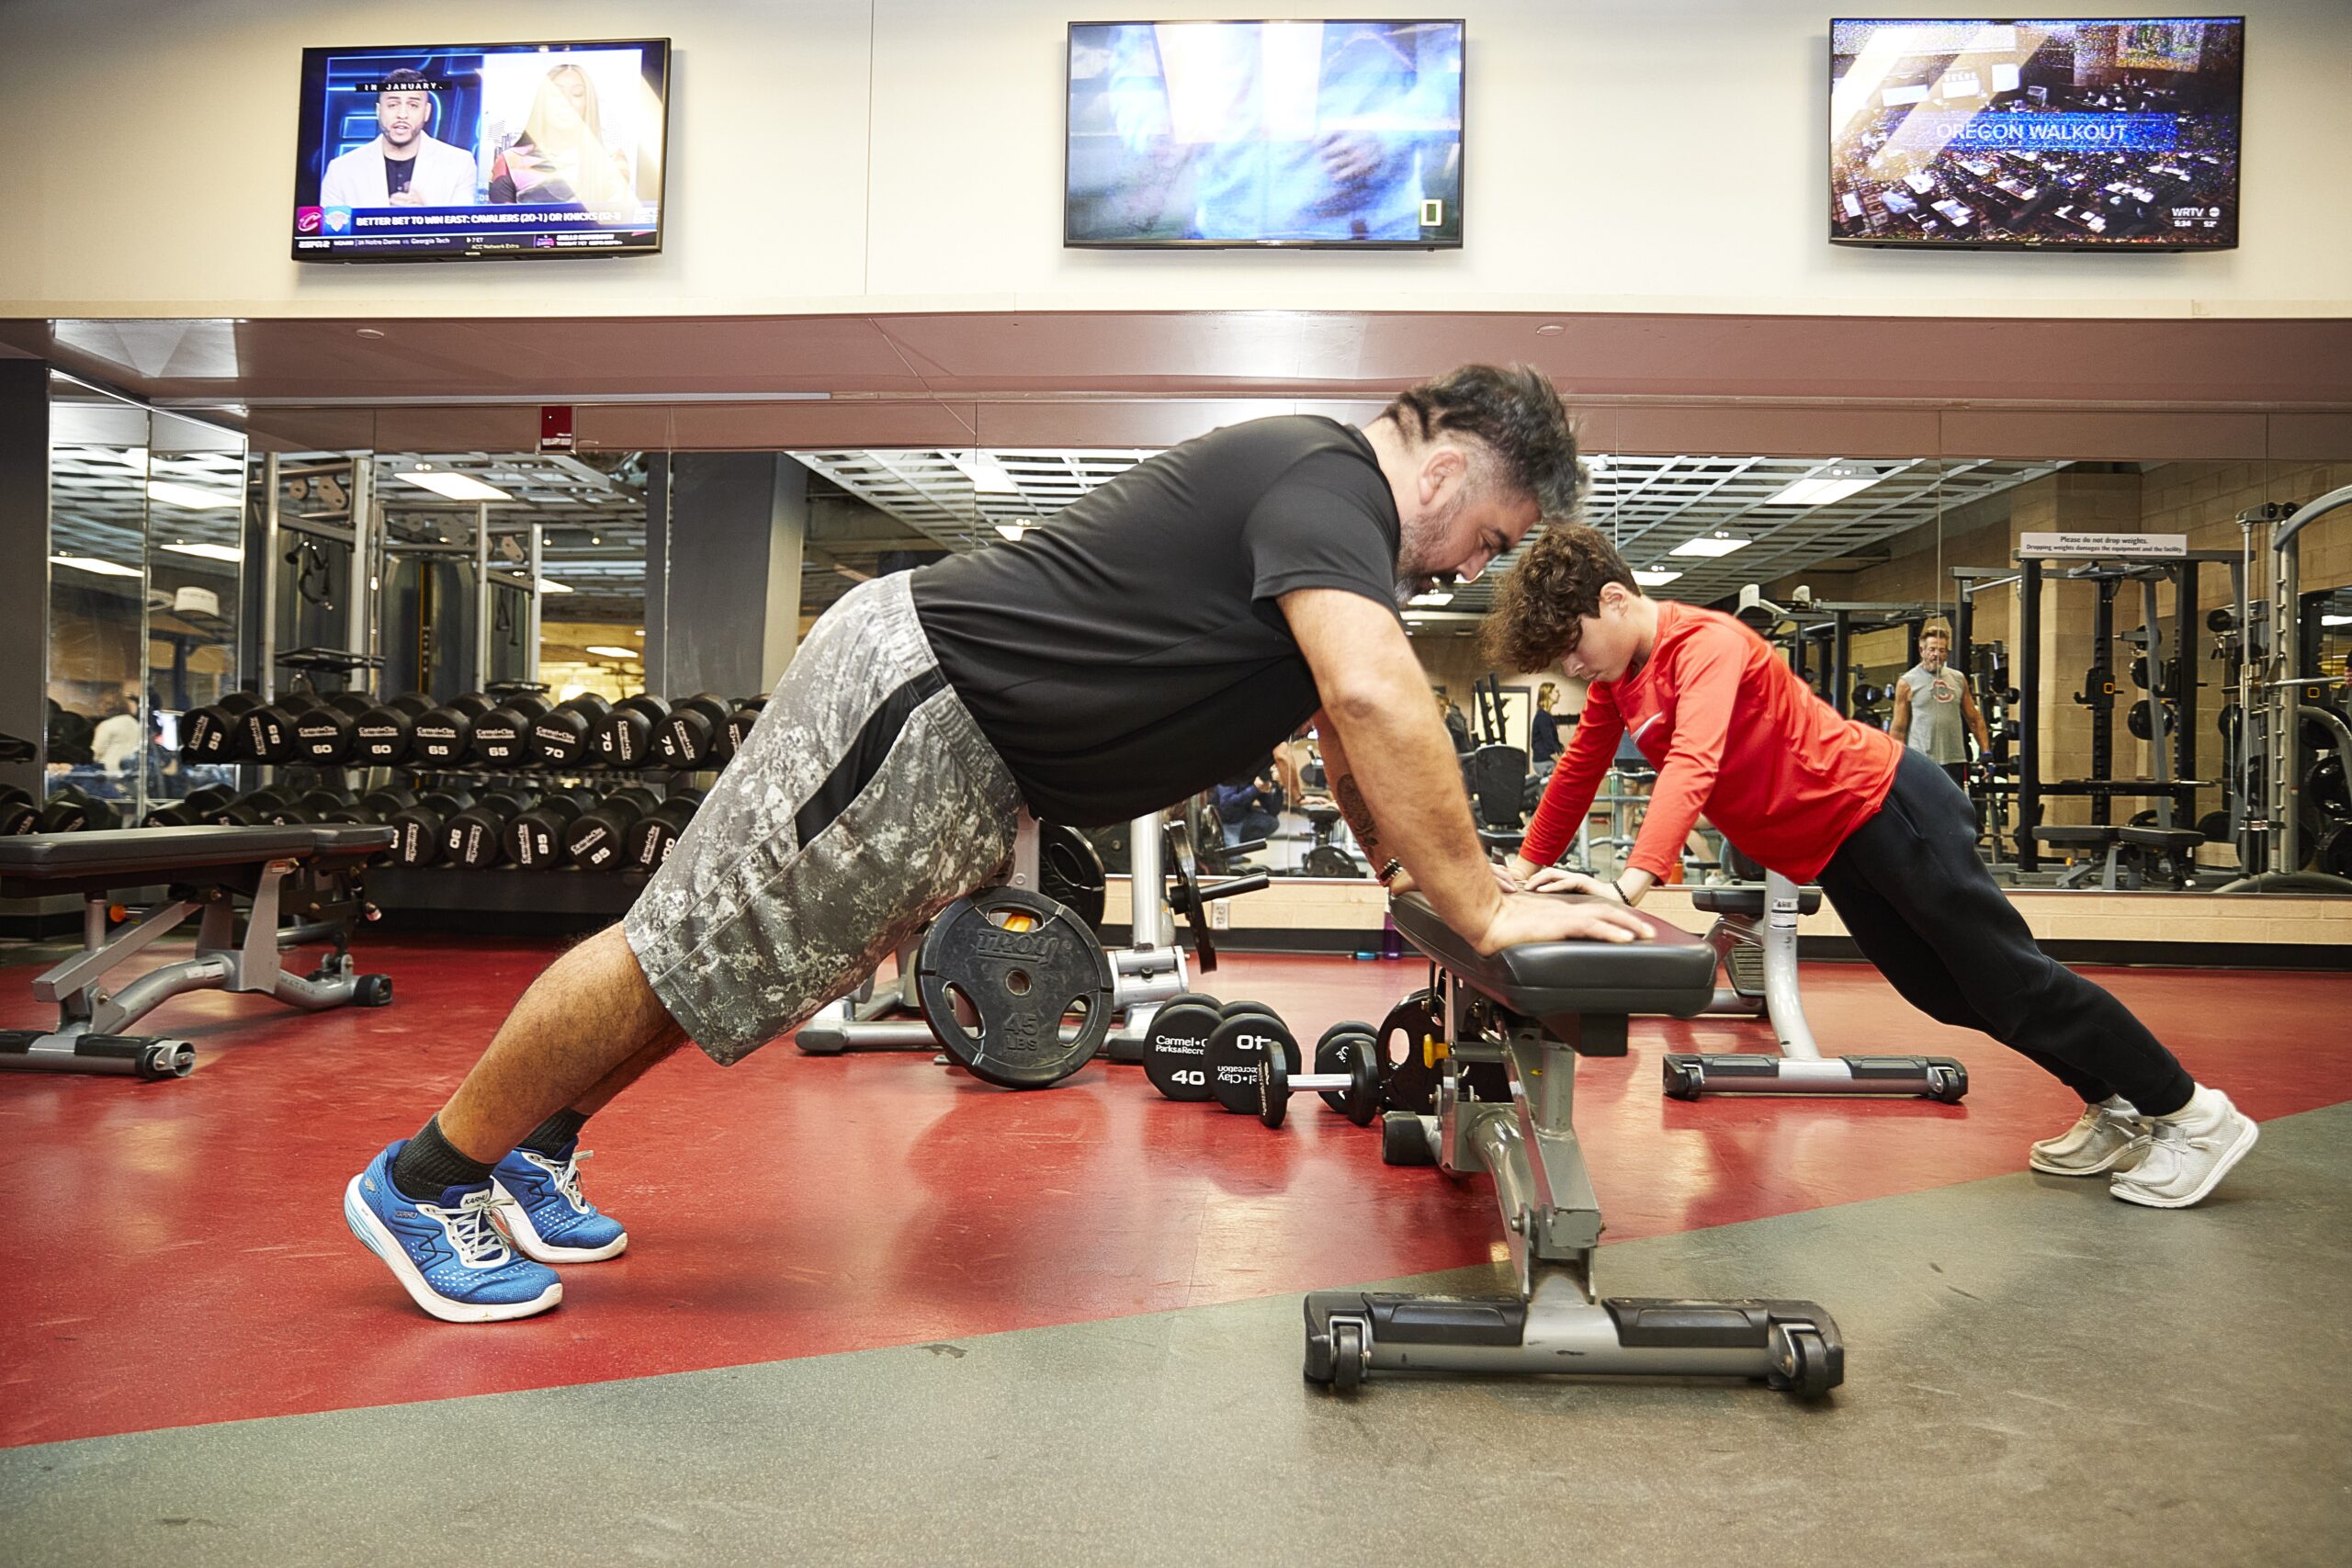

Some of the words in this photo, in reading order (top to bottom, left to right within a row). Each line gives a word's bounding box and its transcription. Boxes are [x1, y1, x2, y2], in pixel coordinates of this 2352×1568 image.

[386, 82, 443, 91] JANUARY.
[1936, 123, 2023, 140] OREGON
[2024, 123, 2127, 141] WALKOUT
[356, 217, 390, 226] BETTER
[392, 216, 410, 226] BET
[412, 216, 424, 225] TO
[424, 215, 444, 225] WIN
[445, 214, 470, 224] EAST:
[471, 212, 520, 223] CAVALIERS
[548, 212, 562, 222] OR
[563, 211, 598, 221] KNICKS
[2171, 208, 2204, 217] WRTV
[411, 237, 435, 245] Georgia
[2053, 544, 2075, 552] weights
[2105, 536, 2120, 545] drop
[2121, 536, 2148, 546] weights.
[601, 731, 613, 752] 70
[662, 735, 675, 756] 75
[428, 745, 448, 755] 65
[489, 747, 509, 757] 65
[544, 746, 564, 759] 70
[591, 846, 611, 864] 95
[978, 929, 1058, 965] TROY
[1004, 1012, 1037, 1035] 45
[1007, 1036, 1037, 1051] LBS
[1155, 1044, 1204, 1055] Parks&Recre
[1171, 1069, 1205, 1086] 40
